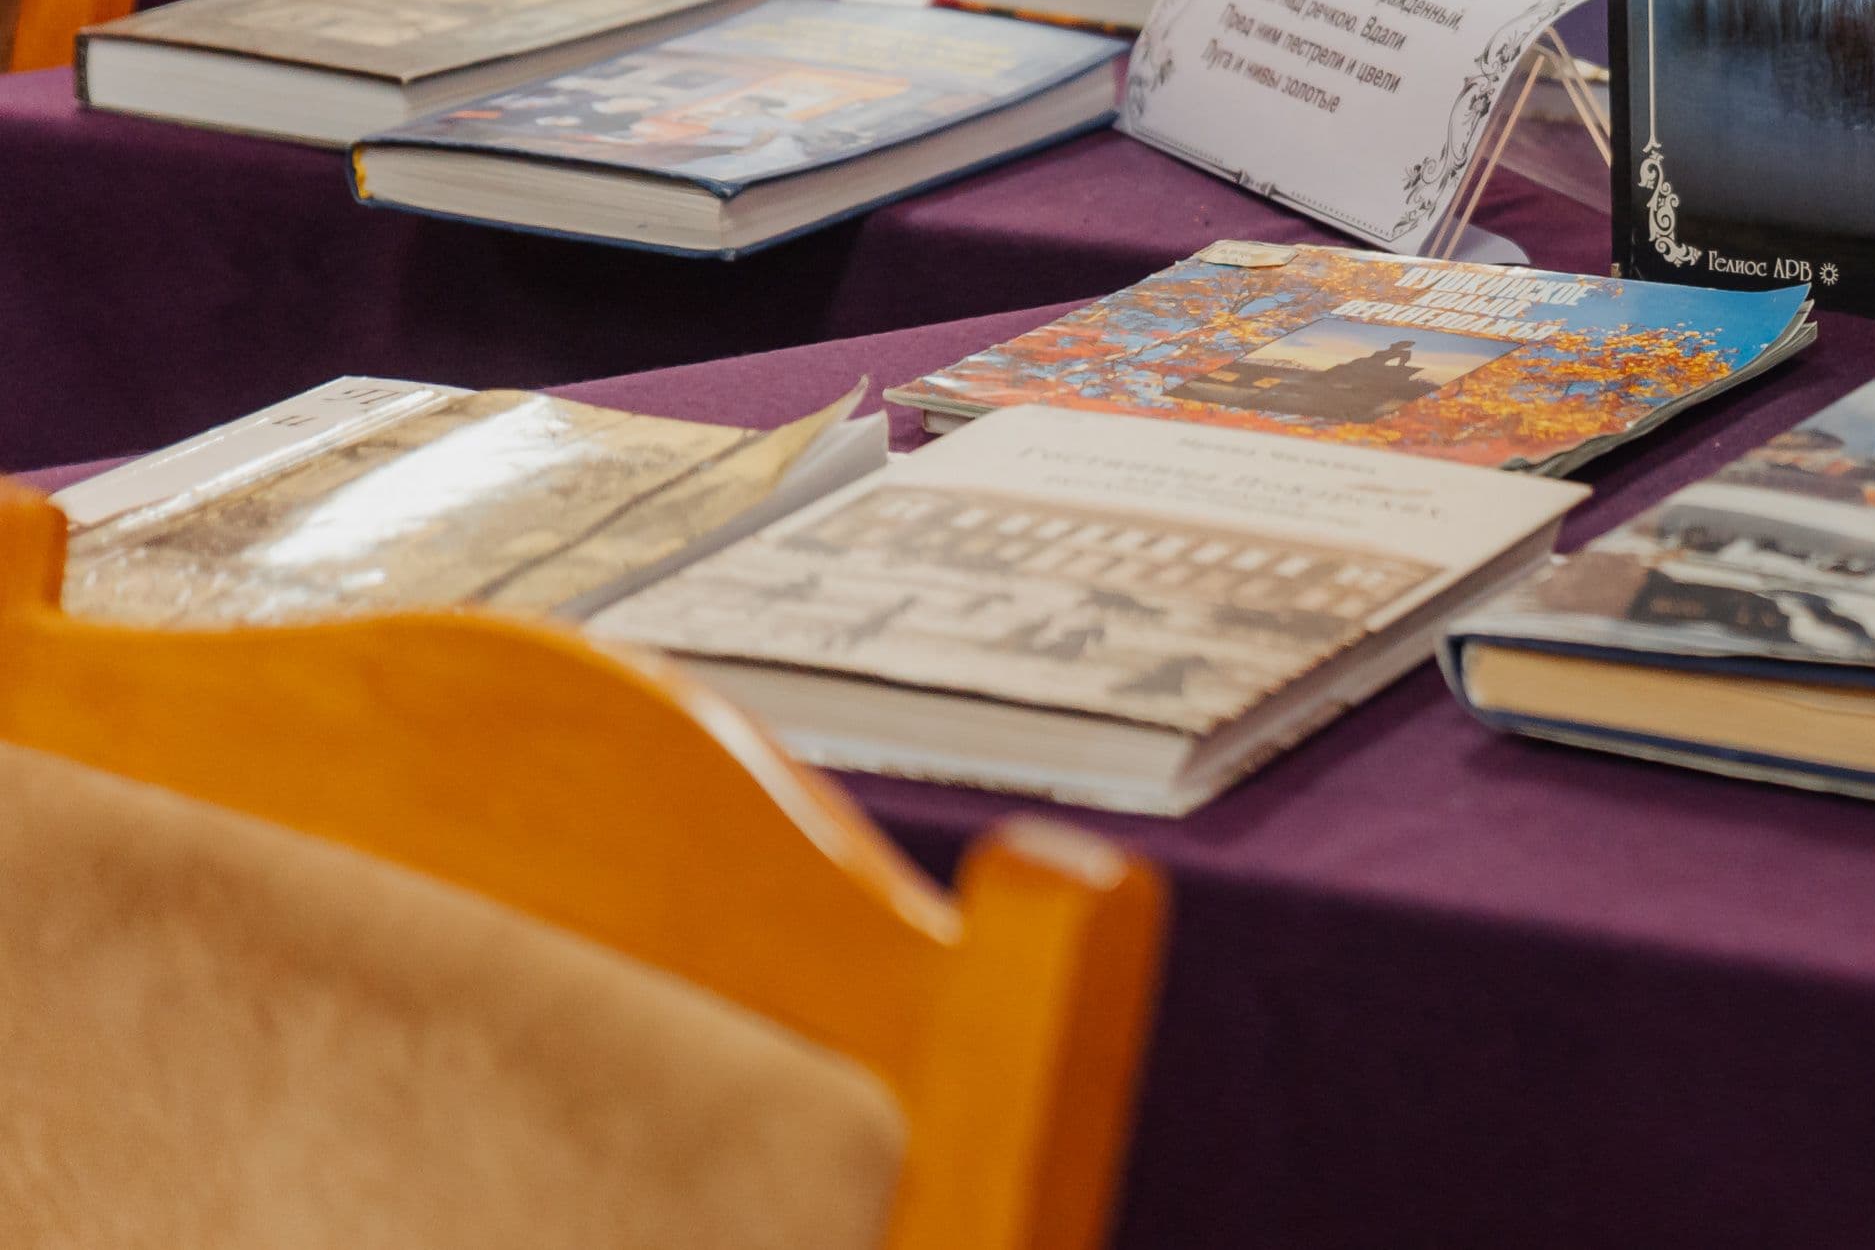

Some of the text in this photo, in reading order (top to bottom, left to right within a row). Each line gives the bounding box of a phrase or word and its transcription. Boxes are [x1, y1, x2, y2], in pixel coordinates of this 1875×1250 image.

[1220, 2, 1402, 94] Пред ним пестрели и цвели
[1303, 0, 1358, 34] речкою.
[1360, 16, 1408, 51] Вдали
[1202, 37, 1341, 114] Луга и нивы золотые
[1394, 266, 1598, 307] ПУШКИНСКОЕ
[1708, 250, 1813, 282] Гелиос АРВ
